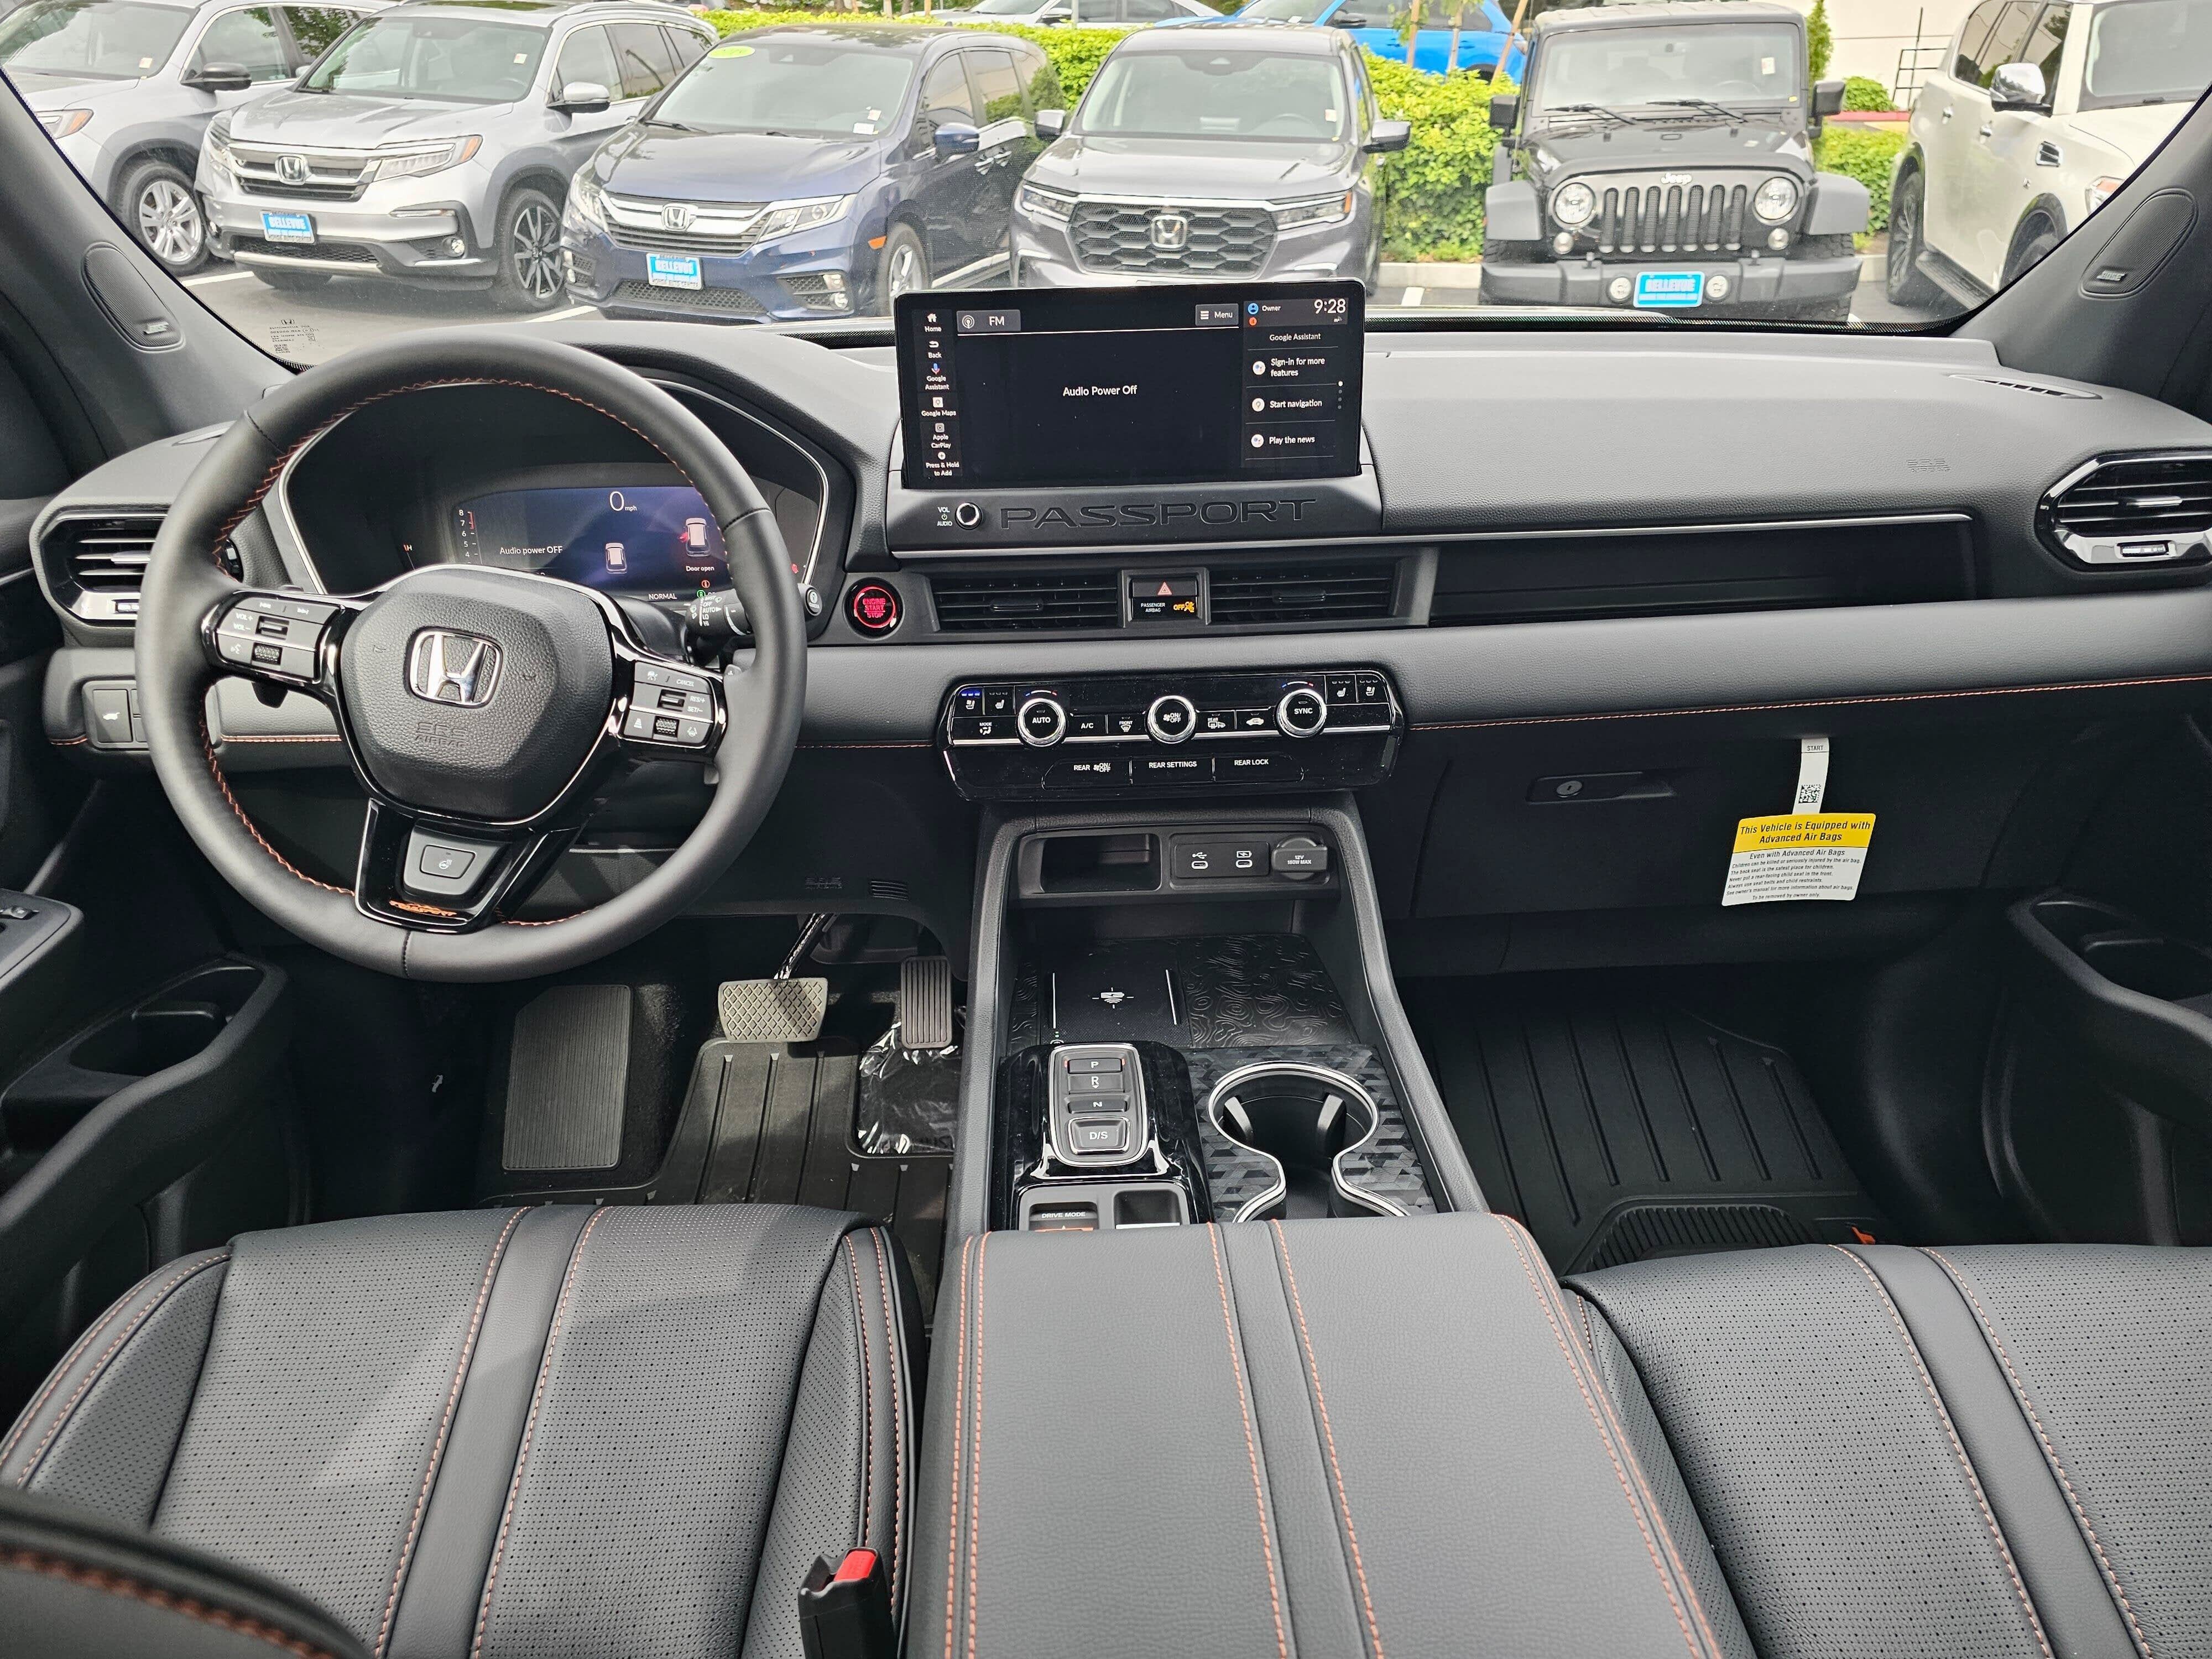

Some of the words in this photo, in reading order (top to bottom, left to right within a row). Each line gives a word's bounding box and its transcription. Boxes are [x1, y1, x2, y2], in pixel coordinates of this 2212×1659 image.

[1661, 172, 1692, 185] Jeep
[655, 260, 695, 275] BELLEVUE
[1314, 298, 1346, 314] 9:28
[989, 316, 1005, 326] FM
[1271, 358, 1295, 367] Sign-in
[1271, 369, 1298, 377] features
[1062, 386, 1089, 397] Audio
[1092, 386, 1120, 395] Power
[1122, 385, 1138, 395] Off
[1287, 399, 1322, 409] navigation
[1269, 437, 1283, 445] Play
[609, 491, 624, 512] 0
[1000, 498, 1317, 529] PASSPORT
[676, 679, 695, 687] CANCEL
[418, 722, 467, 737] SRS
[415, 734, 469, 750] AIRBAG
[1740, 826, 1757, 835] This
[1761, 823, 1791, 832] Vehicle
[1805, 821, 1848, 831] Equipped
[1850, 821, 1870, 830] with
[1759, 833, 1801, 843] Advanced
[1819, 833, 1842, 842] Bags
[1091, 1076, 1099, 1086] R
[1089, 1131, 1108, 1140] D/S
